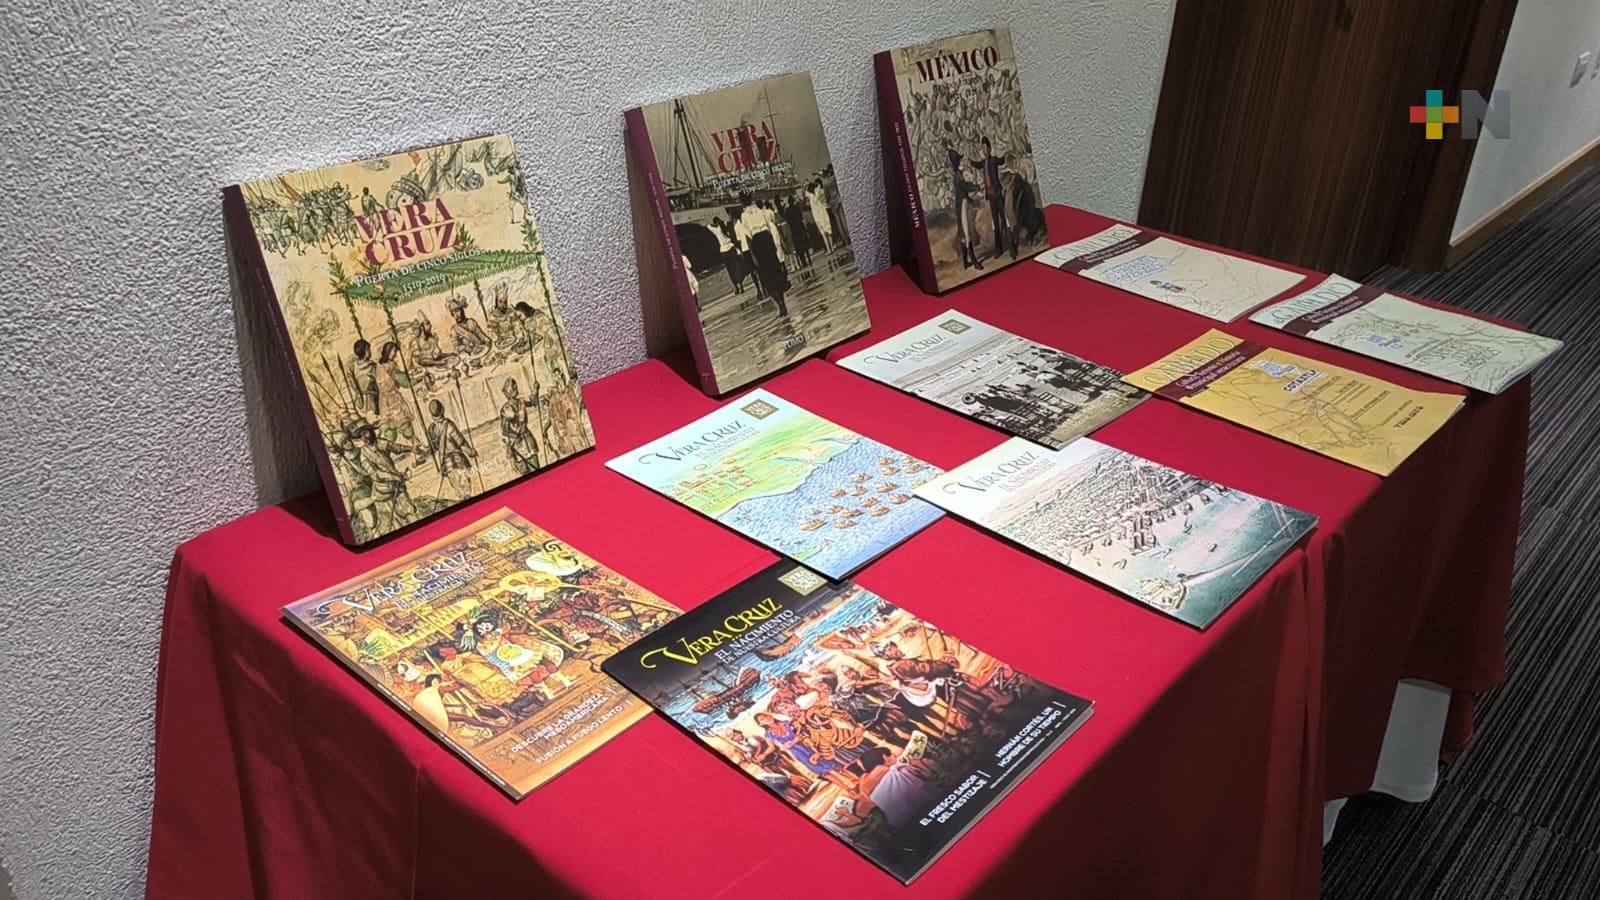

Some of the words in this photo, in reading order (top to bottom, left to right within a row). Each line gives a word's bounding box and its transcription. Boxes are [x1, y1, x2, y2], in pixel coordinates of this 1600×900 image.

[916, 46, 997, 83] MÉXICO
[711, 121, 774, 152] VERA
[718, 141, 778, 174] CRUZ
[354, 198, 454, 240] VERA
[365, 222, 460, 267] CRUZ
[354, 271, 399, 288] PUERTA
[401, 264, 417, 277] DE
[417, 257, 447, 271] CINCO
[449, 247, 481, 263] SIGLOS
[402, 273, 446, 293] 1519-2019
[1143, 338, 1234, 384] CABILDO
[638, 440, 708, 464] VERA
[702, 420, 746, 443] CRUZ
[943, 472, 1008, 494] VERA
[997, 451, 1040, 474] CRUZ
[316, 580, 410, 615] VERA
[411, 552, 471, 583] CRUZ
[640, 629, 732, 669] VERA
[723, 597, 783, 633] CRUZ
[714, 649, 732, 660] EL
[730, 609, 794, 651] NACIMIENTO
[722, 655, 735, 665] DE
[767, 615, 801, 638] CULTURA
[511, 723, 553, 753] DESCUBRE
[552, 717, 564, 728] LA
[563, 693, 604, 720] GRANDEZA
[544, 695, 609, 740] MESOAMERICANA
[572, 721, 599, 741] FUEGO
[598, 705, 623, 724] LENTO
[1041, 706, 1054, 716] UN
[997, 743, 1026, 768] HOMBRE
[1022, 735, 1034, 745] DE
[1030, 728, 1042, 738] SU
[1038, 709, 1062, 730] TIEMPO
[920, 816, 933, 827] EL
[928, 793, 957, 819] FRESCO
[955, 774, 979, 796] SABOR
[937, 810, 954, 824] DEL
[951, 778, 988, 814] MESTIZAJE
